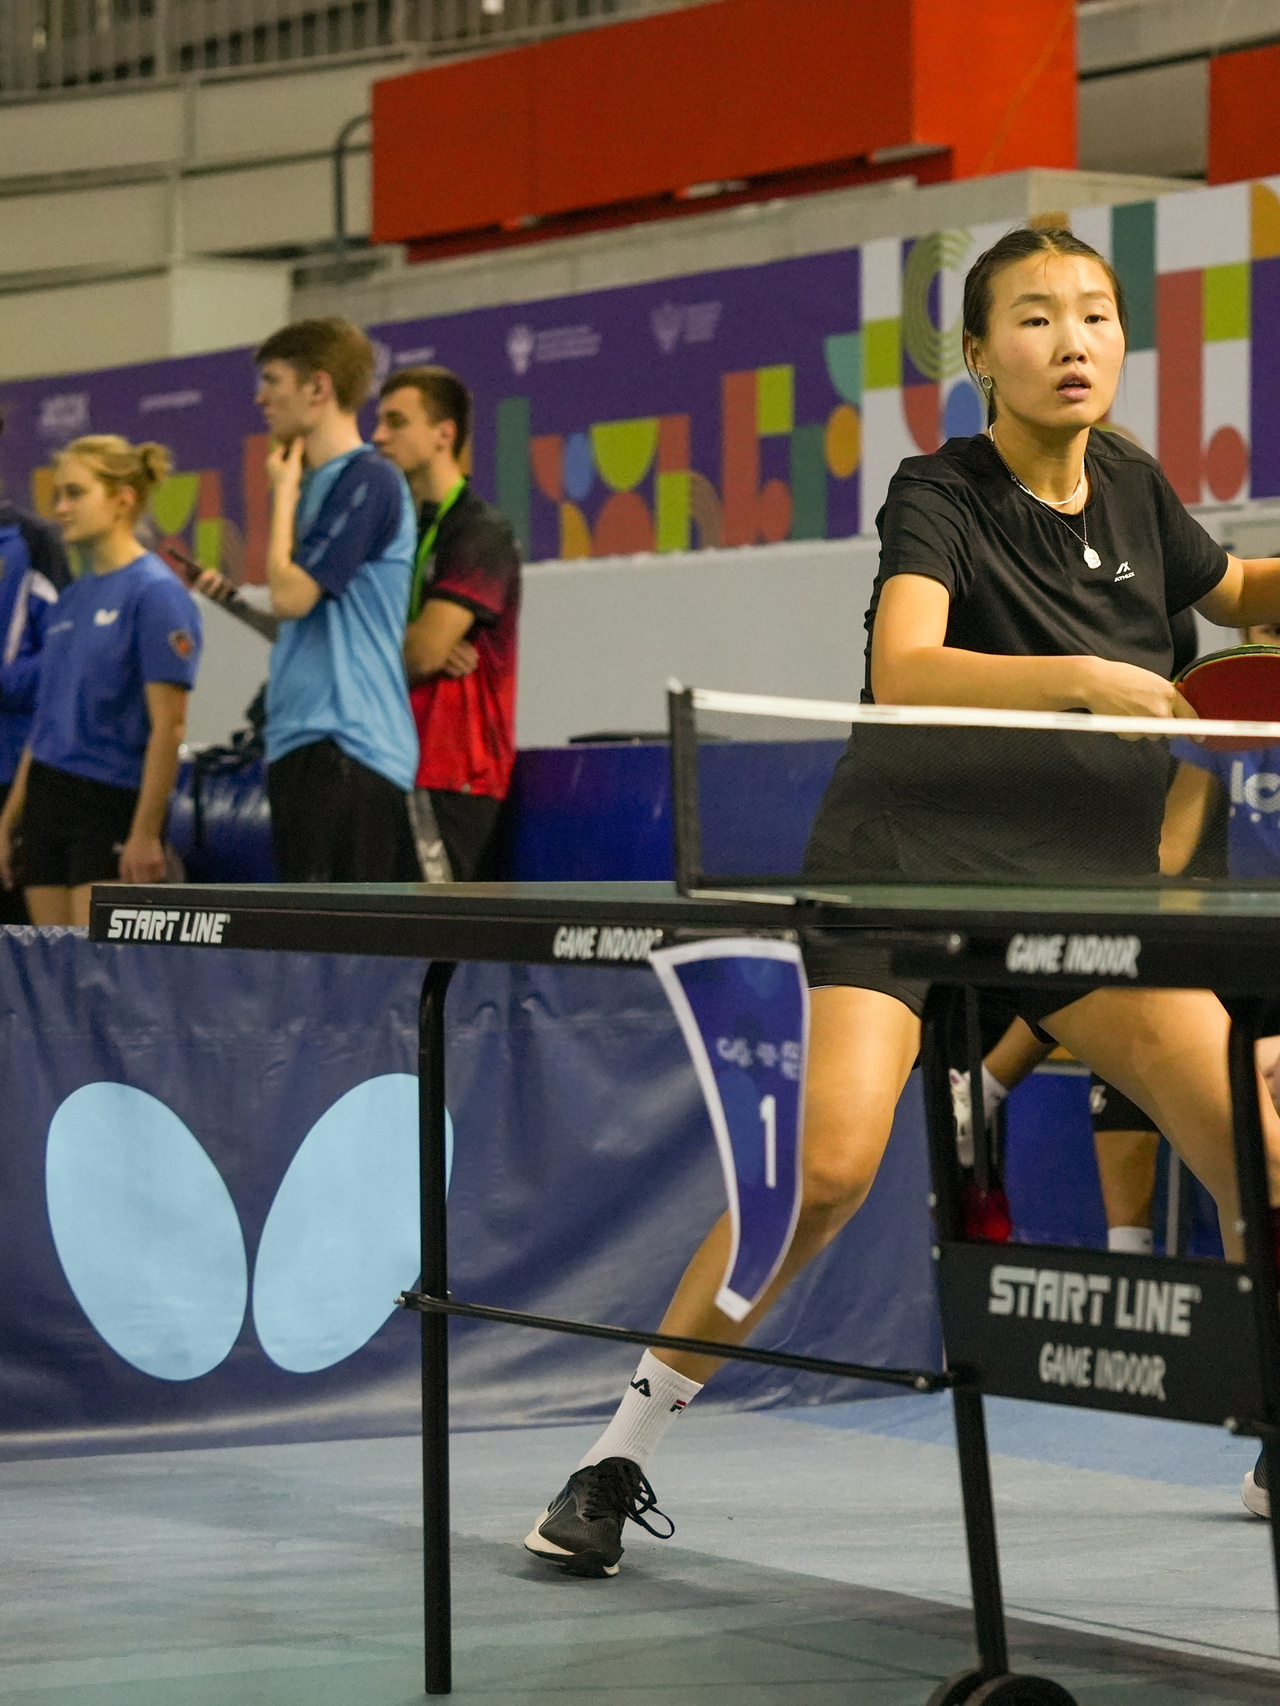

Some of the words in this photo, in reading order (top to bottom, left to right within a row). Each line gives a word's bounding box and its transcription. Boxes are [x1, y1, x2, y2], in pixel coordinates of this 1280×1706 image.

[107, 909, 181, 942] START
[179, 911, 227, 944] LINE
[553, 926, 599, 959] GAME
[1006, 933, 1066, 975] GAME
[1062, 934, 1141, 979] INDOOR
[759, 1094, 776, 1189] 1
[988, 1264, 1112, 1327] START
[1114, 1277, 1200, 1337] LINE
[1038, 1341, 1093, 1389] GAME
[1093, 1347, 1167, 1401] INDOOR
